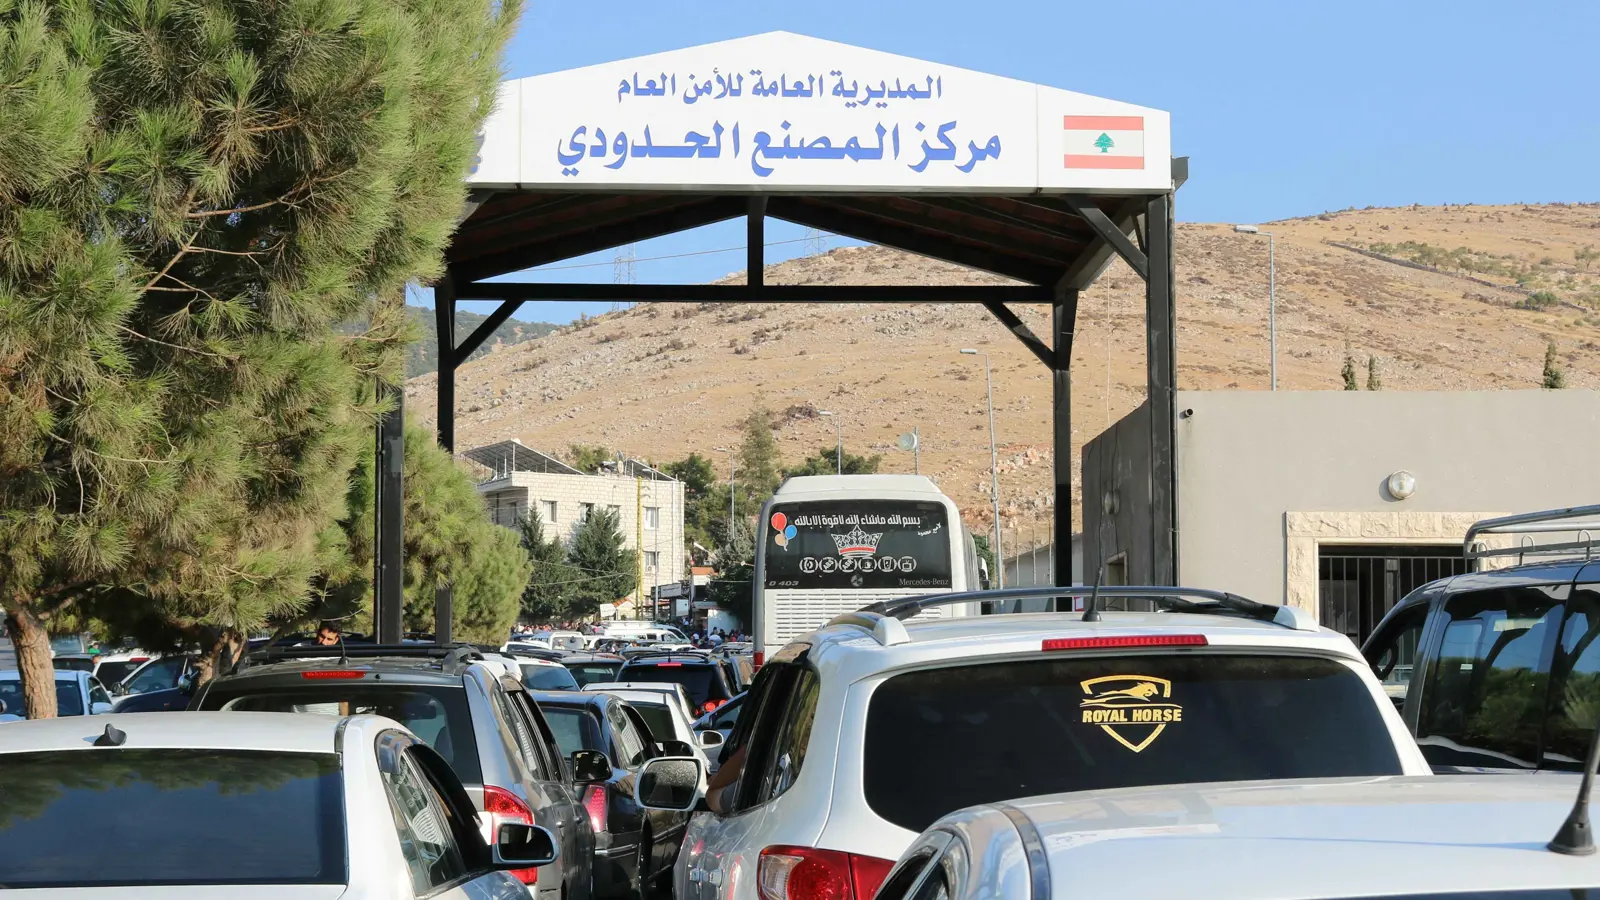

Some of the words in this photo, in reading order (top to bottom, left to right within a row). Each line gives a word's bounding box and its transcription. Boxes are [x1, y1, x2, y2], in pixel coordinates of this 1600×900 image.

[617, 71, 676, 104] العام
[682, 67, 744, 105] للأمن
[749, 69, 824, 98] العامة
[829, 70, 942, 108] المديرية
[557, 120, 740, 177] الحدودي
[751, 119, 900, 178] المصنع
[906, 121, 1001, 174] مركز
[845, 514, 860, 525] الله
[887, 514, 902, 525] الله
[902, 516, 921, 529] بسم
[898, 577, 949, 587] Mercedes-Benz
[1082, 709, 1128, 723] ROYAL
[1132, 709, 1182, 722] HORSE
